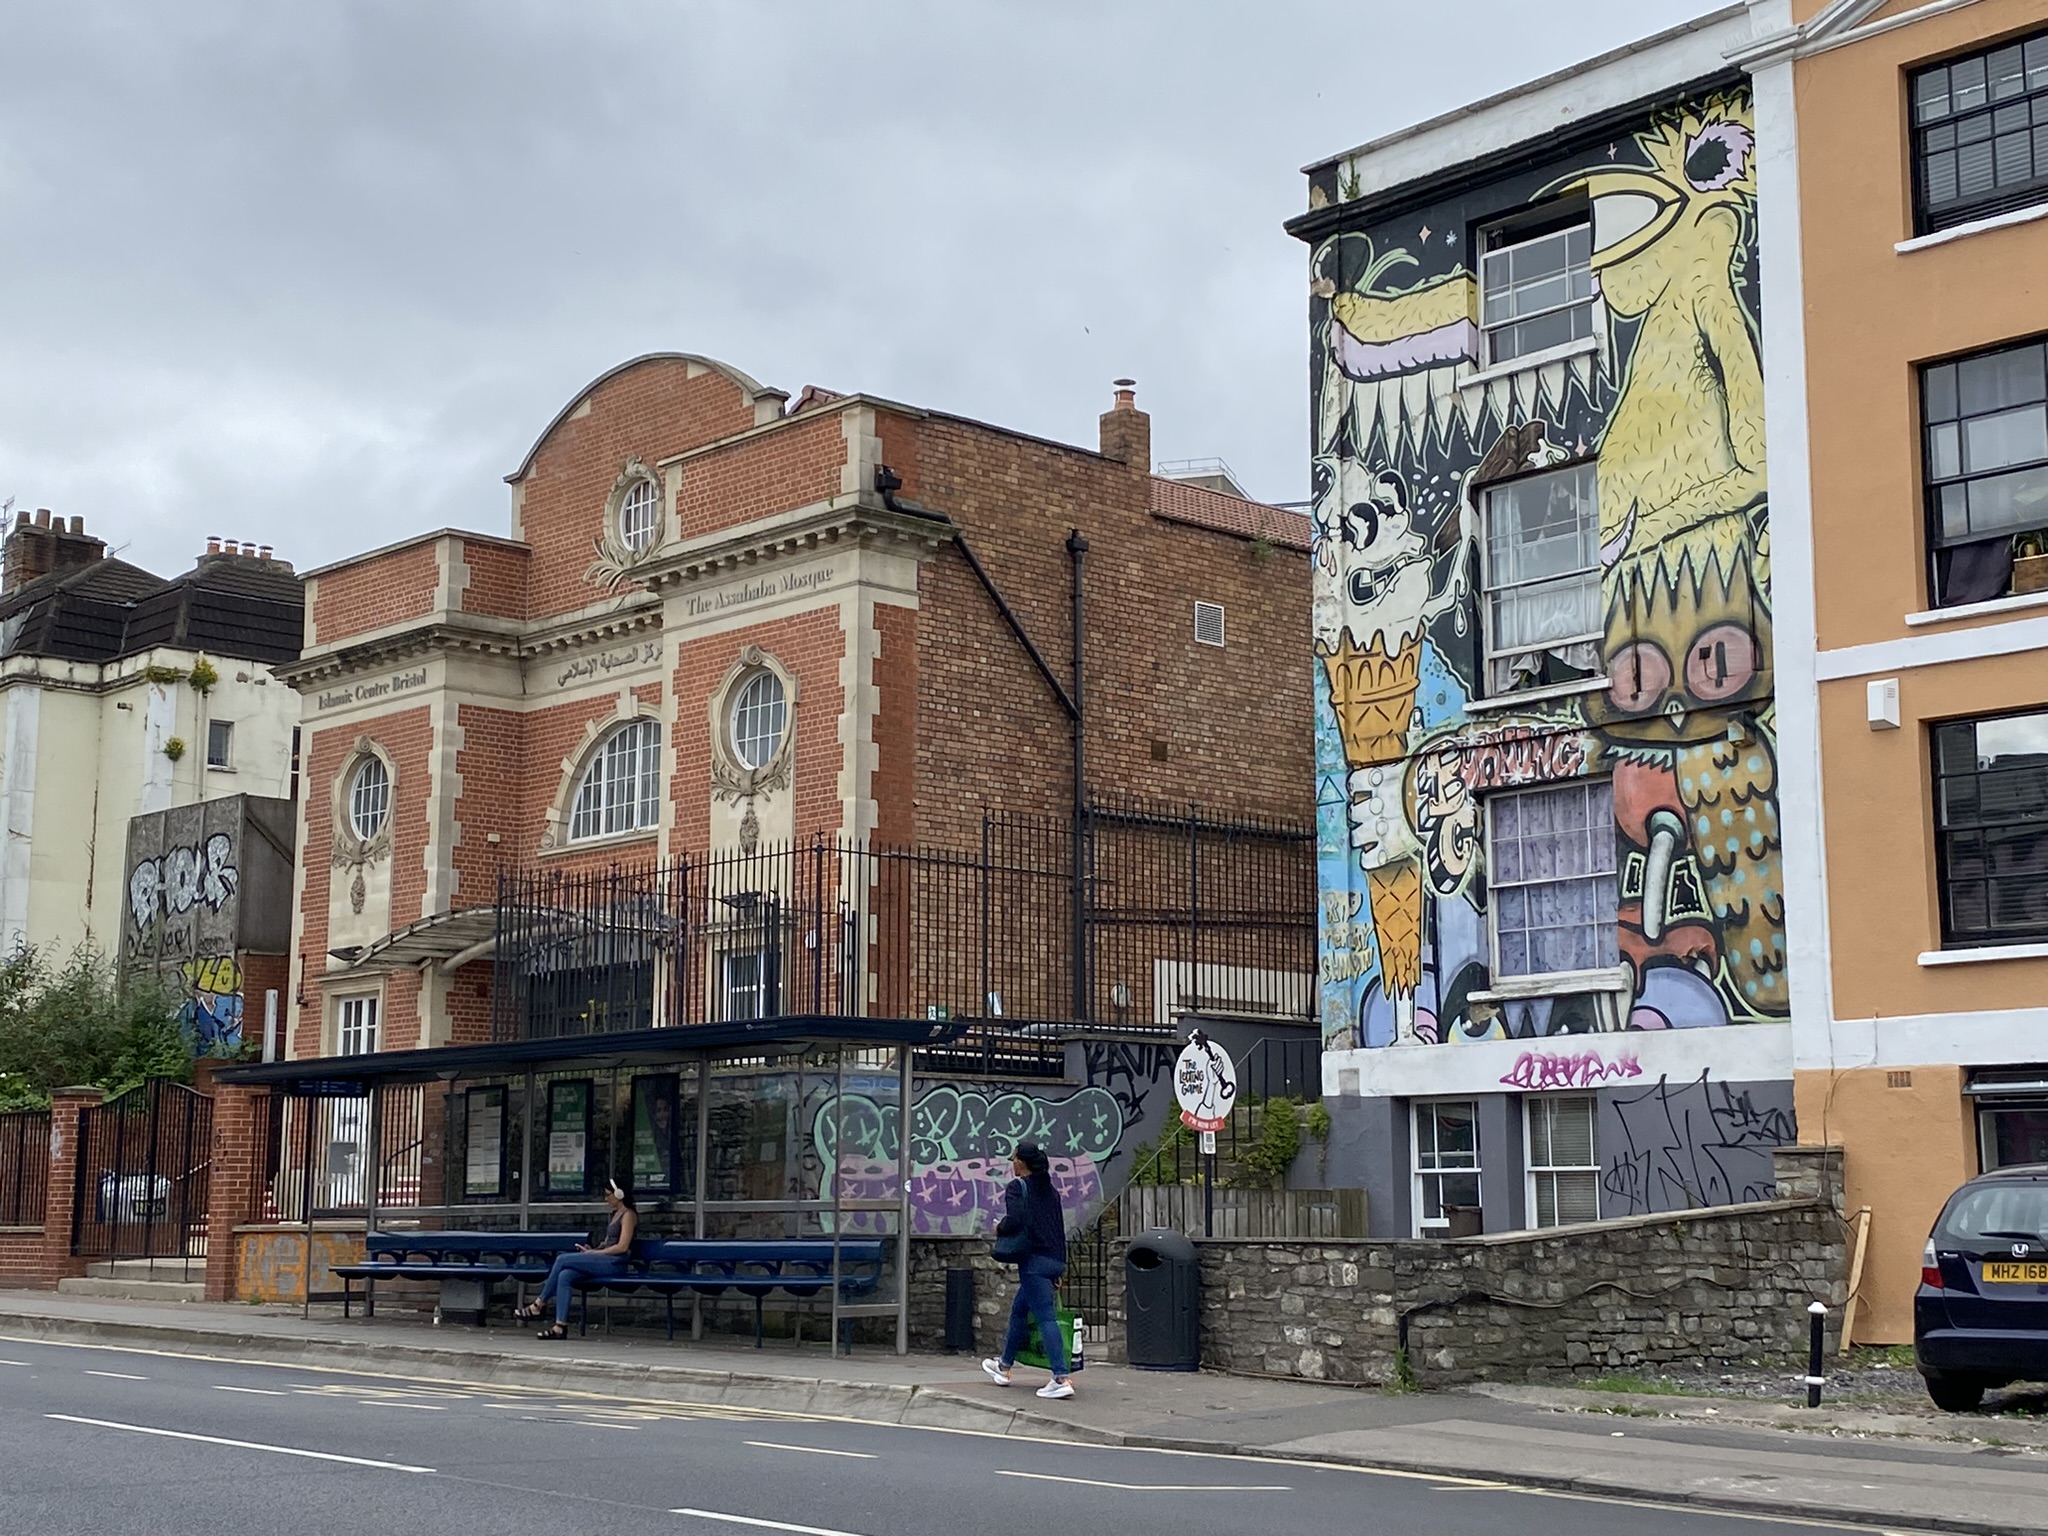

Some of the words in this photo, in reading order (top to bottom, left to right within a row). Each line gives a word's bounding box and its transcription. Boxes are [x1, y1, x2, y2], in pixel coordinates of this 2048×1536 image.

[686, 595, 712, 616] The
[714, 579, 776, 610] Assahaba
[780, 568, 834, 593] Mosque
[641, 643, 663, 664] ركز
[318, 688, 353, 710] Islamic
[355, 682, 390, 701] Centre
[392, 668, 427, 692] Bristol
[1182, 1058, 1198, 1070] The
